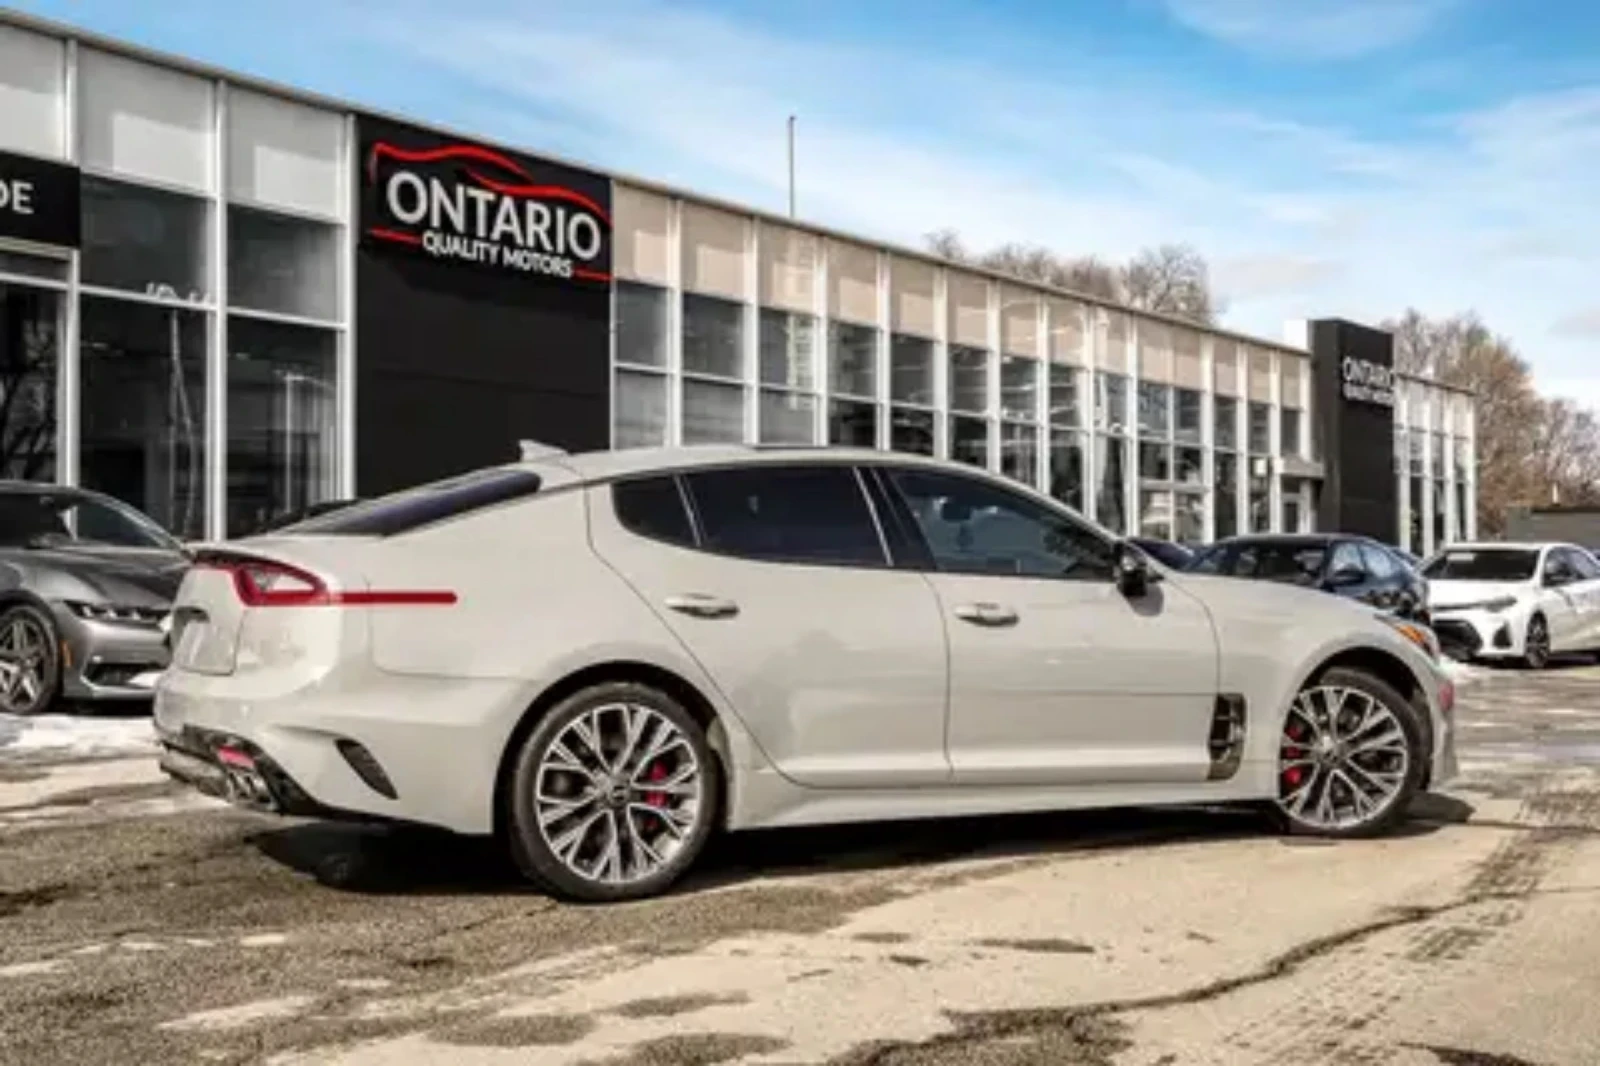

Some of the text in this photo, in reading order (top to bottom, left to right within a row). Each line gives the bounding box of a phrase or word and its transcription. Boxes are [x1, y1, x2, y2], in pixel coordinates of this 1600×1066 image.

[387, 170, 601, 260] ONTARIO
[422, 230, 573, 279] QUALITY MOTORS
